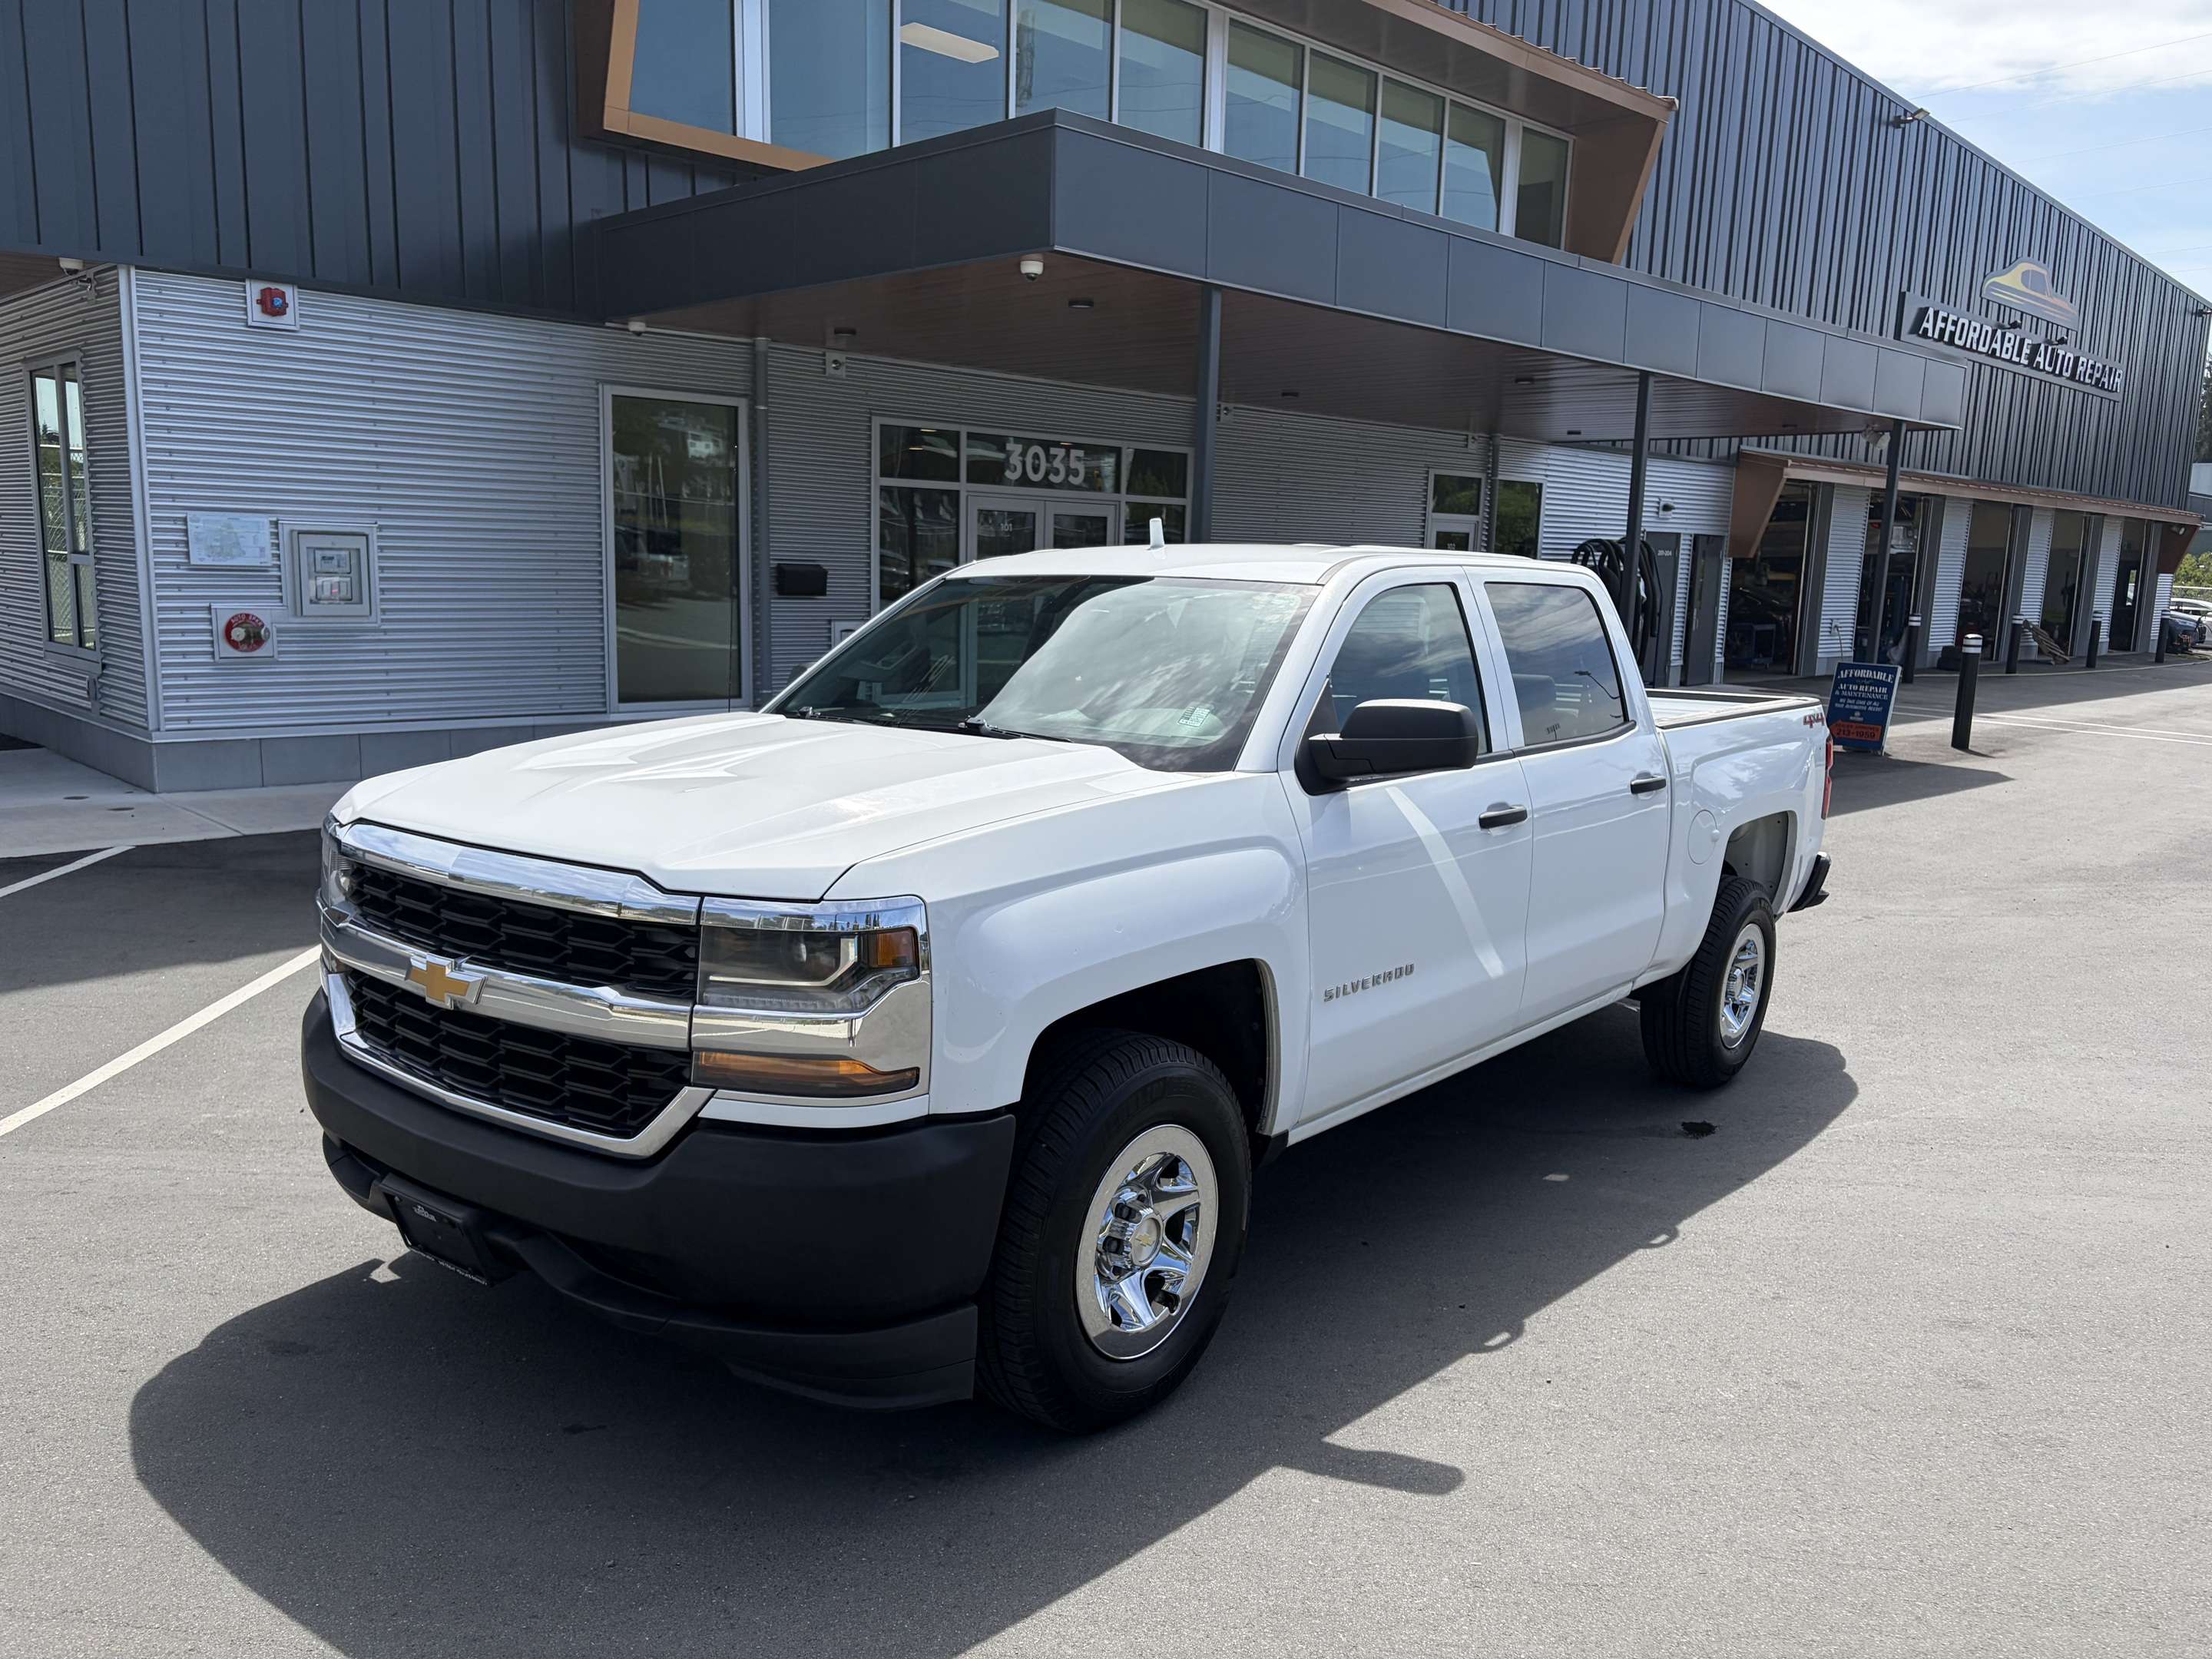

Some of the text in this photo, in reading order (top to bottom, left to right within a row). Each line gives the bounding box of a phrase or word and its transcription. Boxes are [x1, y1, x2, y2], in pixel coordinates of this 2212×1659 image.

[1919, 307, 2124, 393] AFFORDABLE AUTO REPAIR
[1004, 442, 1085, 485] 3035
[1837, 669, 1893, 683] AFFORDABLE
[1859, 684, 1888, 694] REPAIR
[1840, 690, 1889, 700] MAINTENANCE
[1323, 962, 1415, 1002] SILVERADO
